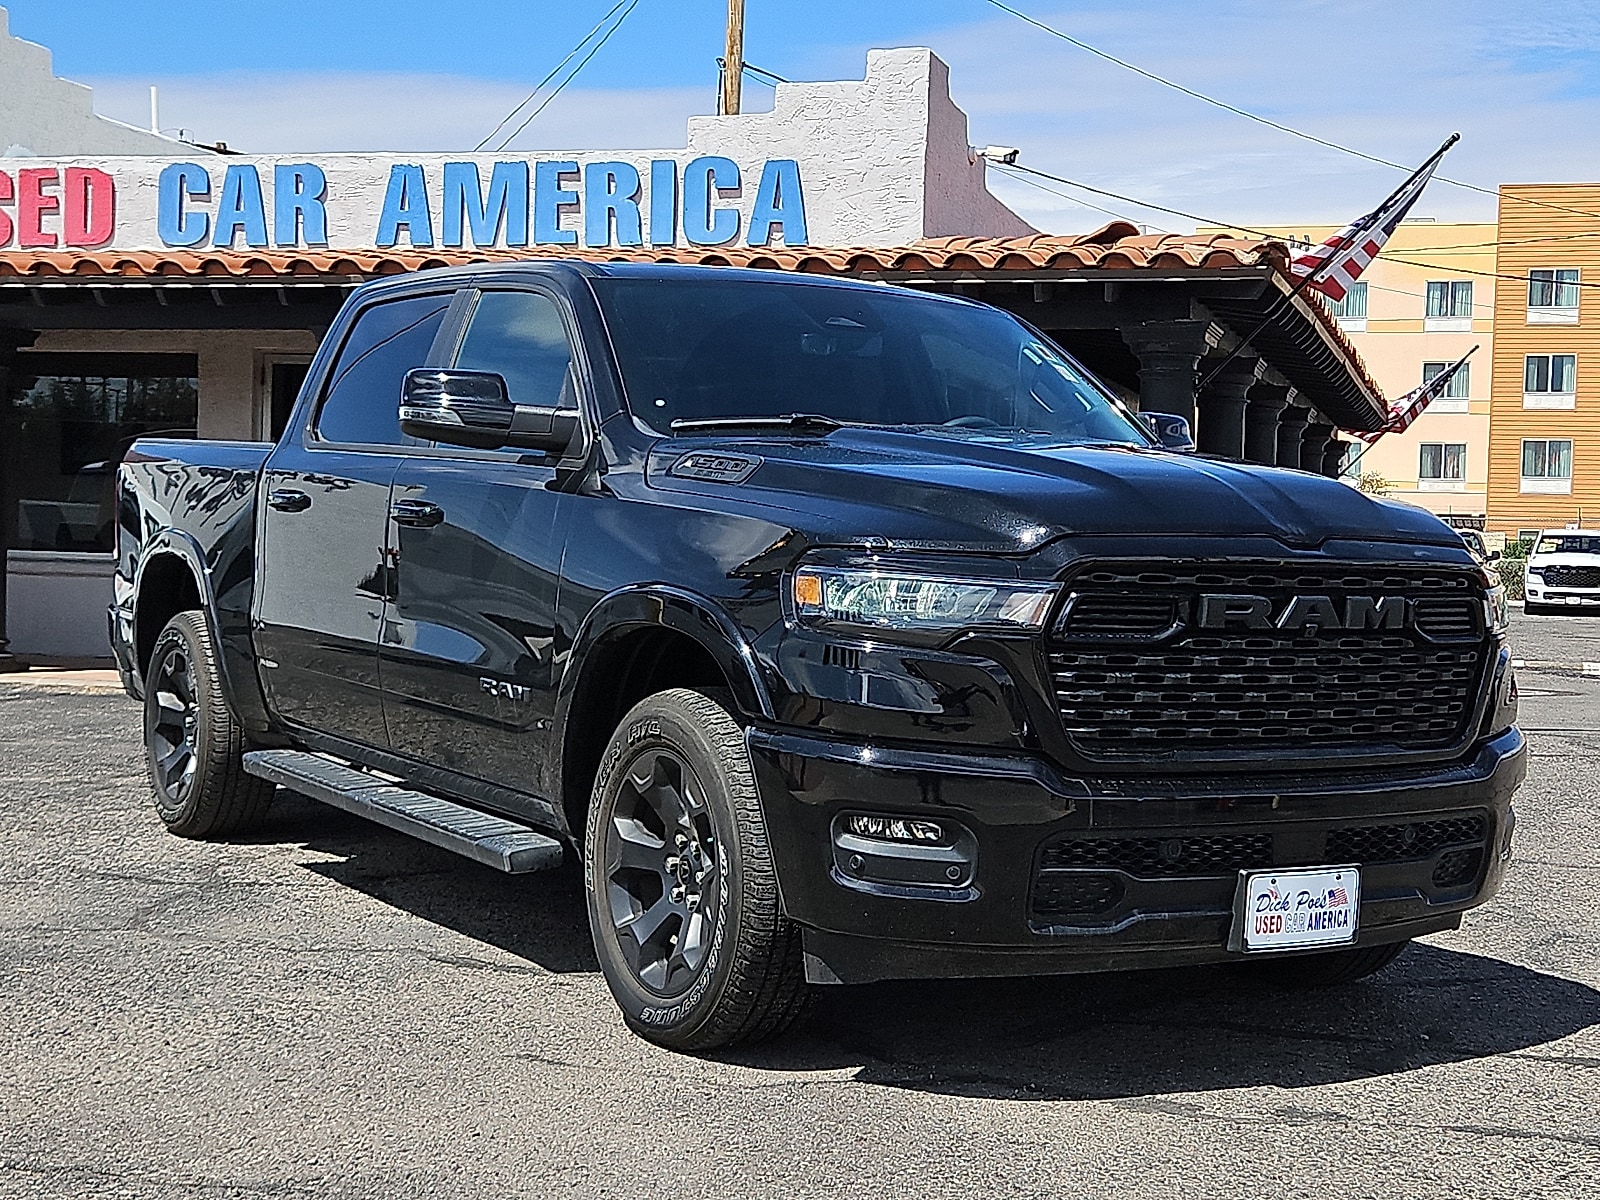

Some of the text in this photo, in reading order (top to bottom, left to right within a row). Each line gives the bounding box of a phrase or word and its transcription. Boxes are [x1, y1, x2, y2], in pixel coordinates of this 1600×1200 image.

[158, 162, 328, 249] CAR
[376, 155, 808, 248] AMERICA
[1199, 594, 1405, 629] RAM
[1255, 889, 1327, 913] Dick Poe's
[1255, 909, 1349, 935] USED CAR AMERICA
